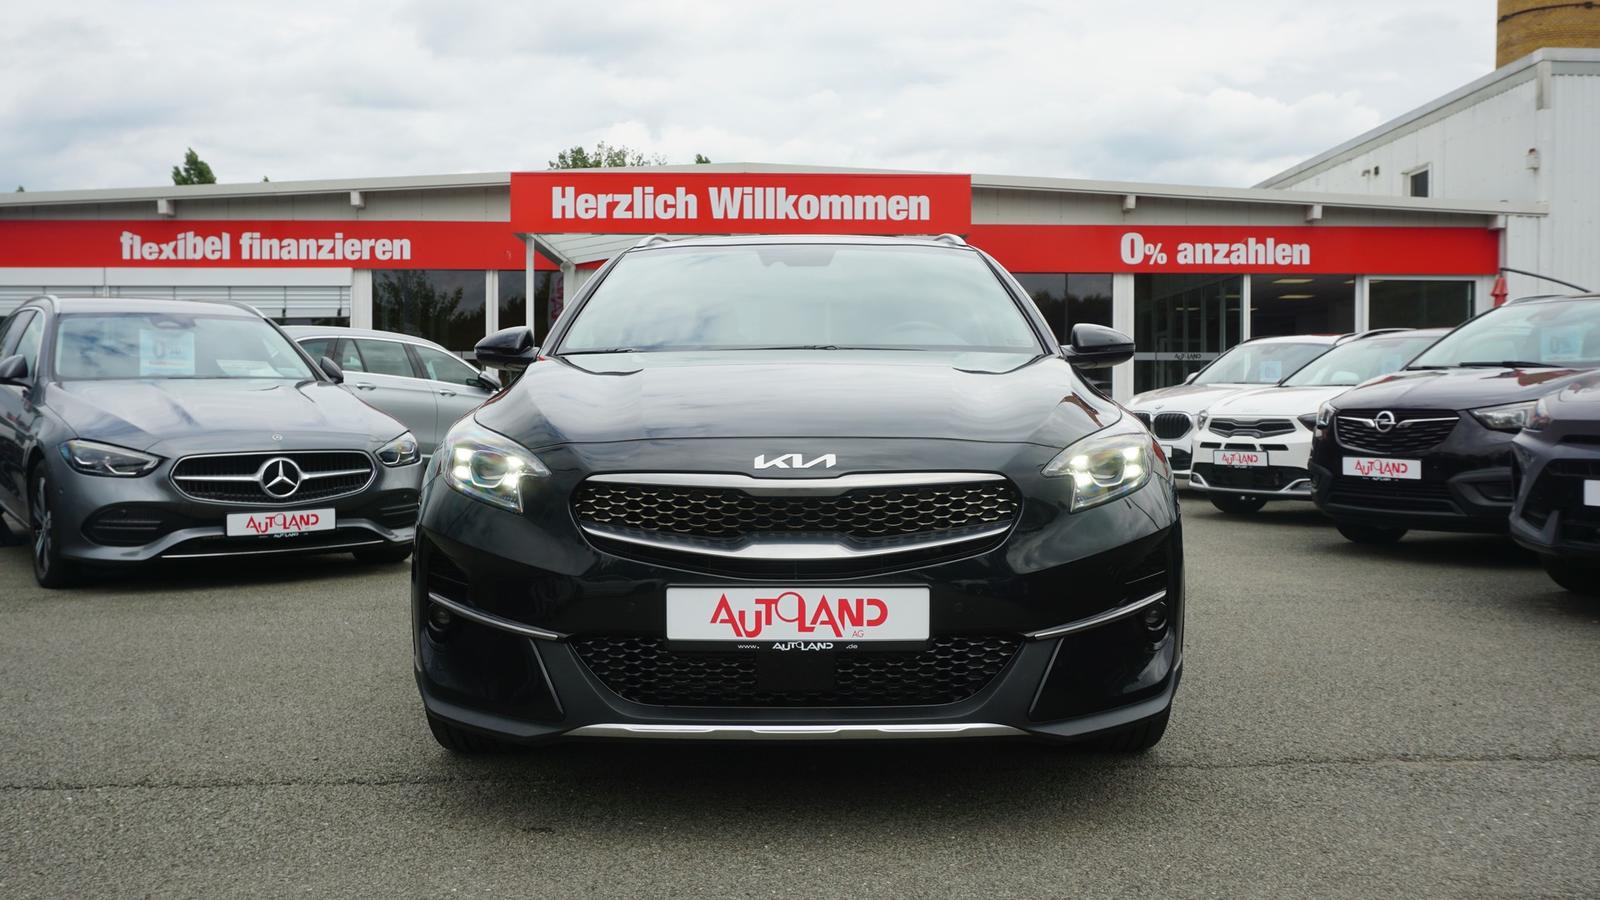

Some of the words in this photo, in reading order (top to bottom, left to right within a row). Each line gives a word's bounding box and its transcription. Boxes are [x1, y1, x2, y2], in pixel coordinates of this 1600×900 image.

[551, 186, 697, 220] Herzlich
[708, 186, 930, 221] Willkommen
[121, 231, 230, 260] flexibel
[240, 232, 410, 260] finanzieren
[1120, 231, 1168, 266] 0%
[1176, 236, 1311, 266] anzahlen
[1174, 353, 1202, 361] AUTLAND
[753, 453, 837, 469] KIA
[1354, 458, 1409, 476] AUTOLAND
[246, 513, 319, 533] AUTOLAND
[710, 592, 888, 638] AUTOLAND
[851, 630, 865, 639] AG
[772, 640, 835, 651] AUTOLAND
